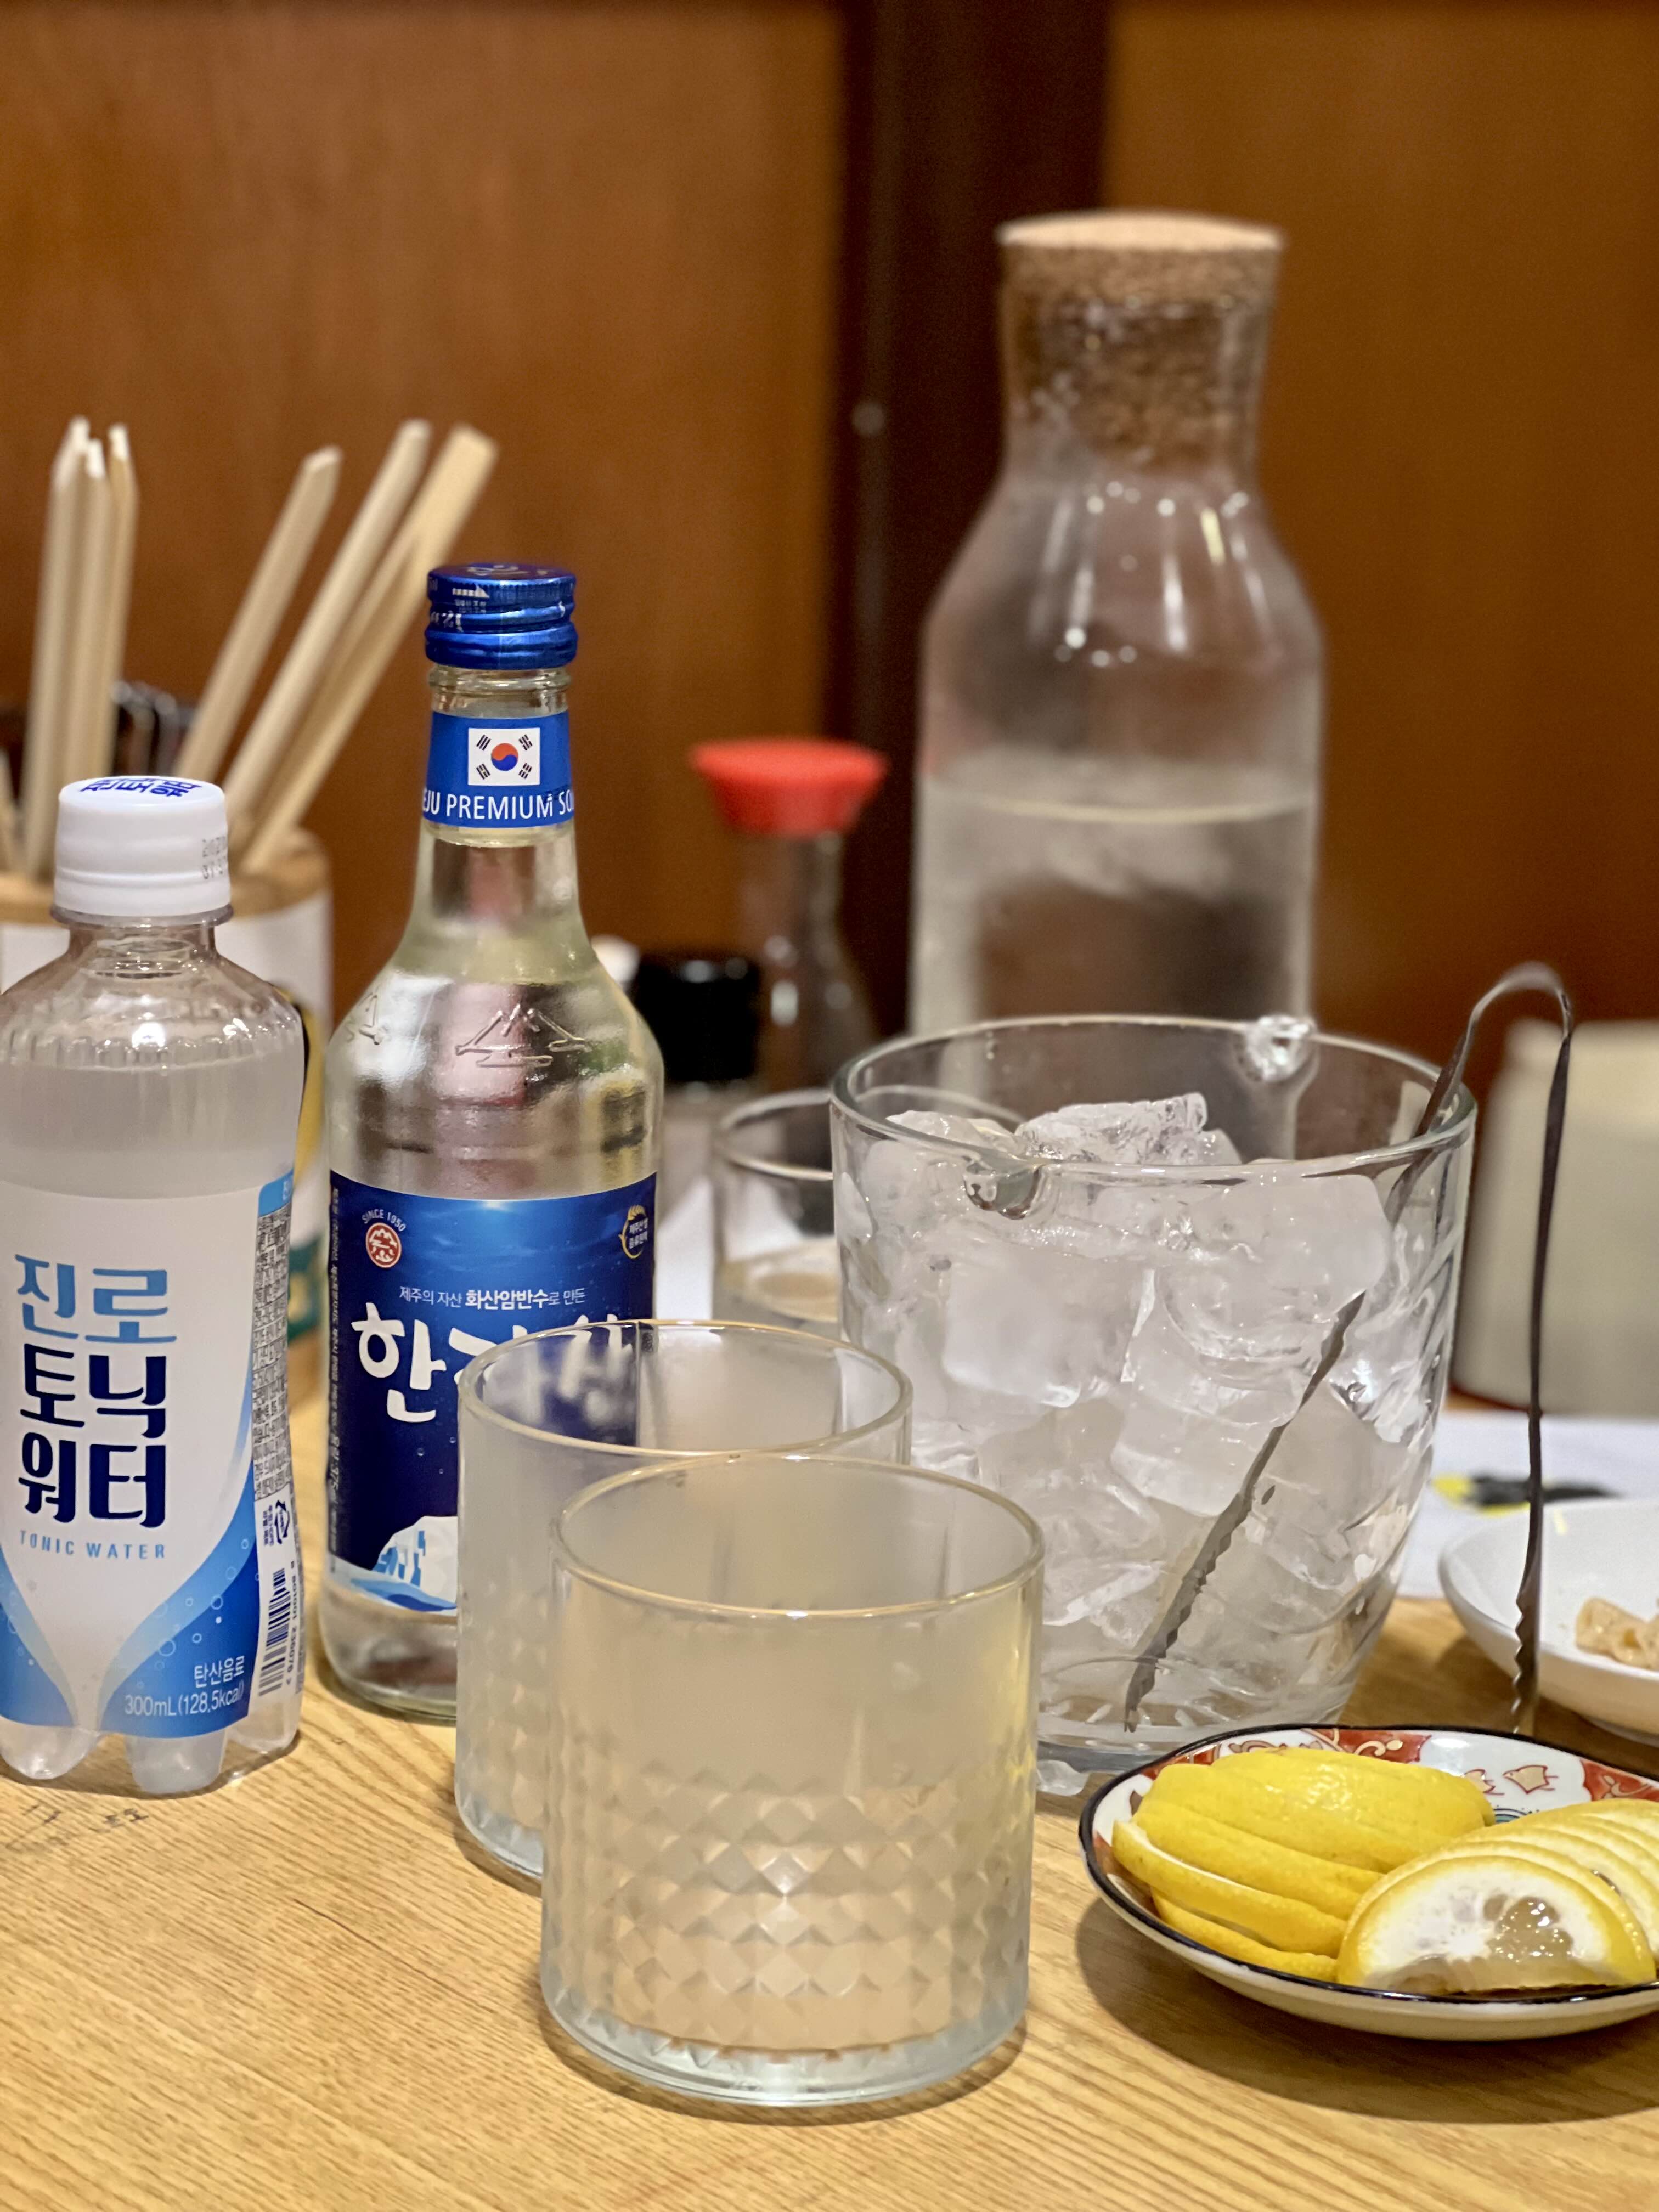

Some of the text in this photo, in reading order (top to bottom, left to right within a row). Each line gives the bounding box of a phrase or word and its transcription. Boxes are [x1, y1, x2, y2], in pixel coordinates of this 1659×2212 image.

[447, 793, 554, 820] PREMIUM
[362, 1209, 406, 1232] SINCE 1950
[14, 1254, 177, 1343] 진로
[399, 1285, 586, 1311] 제주의 자산 화산암반수로 만든
[19, 1344, 167, 1439] 토닉
[18, 1431, 167, 1528] 워터
[20, 1530, 165, 1560] TONIC WATER
[194, 1655, 245, 1689] 탄산음료
[125, 1678, 245, 1717] 300mL(128.5kcal)
